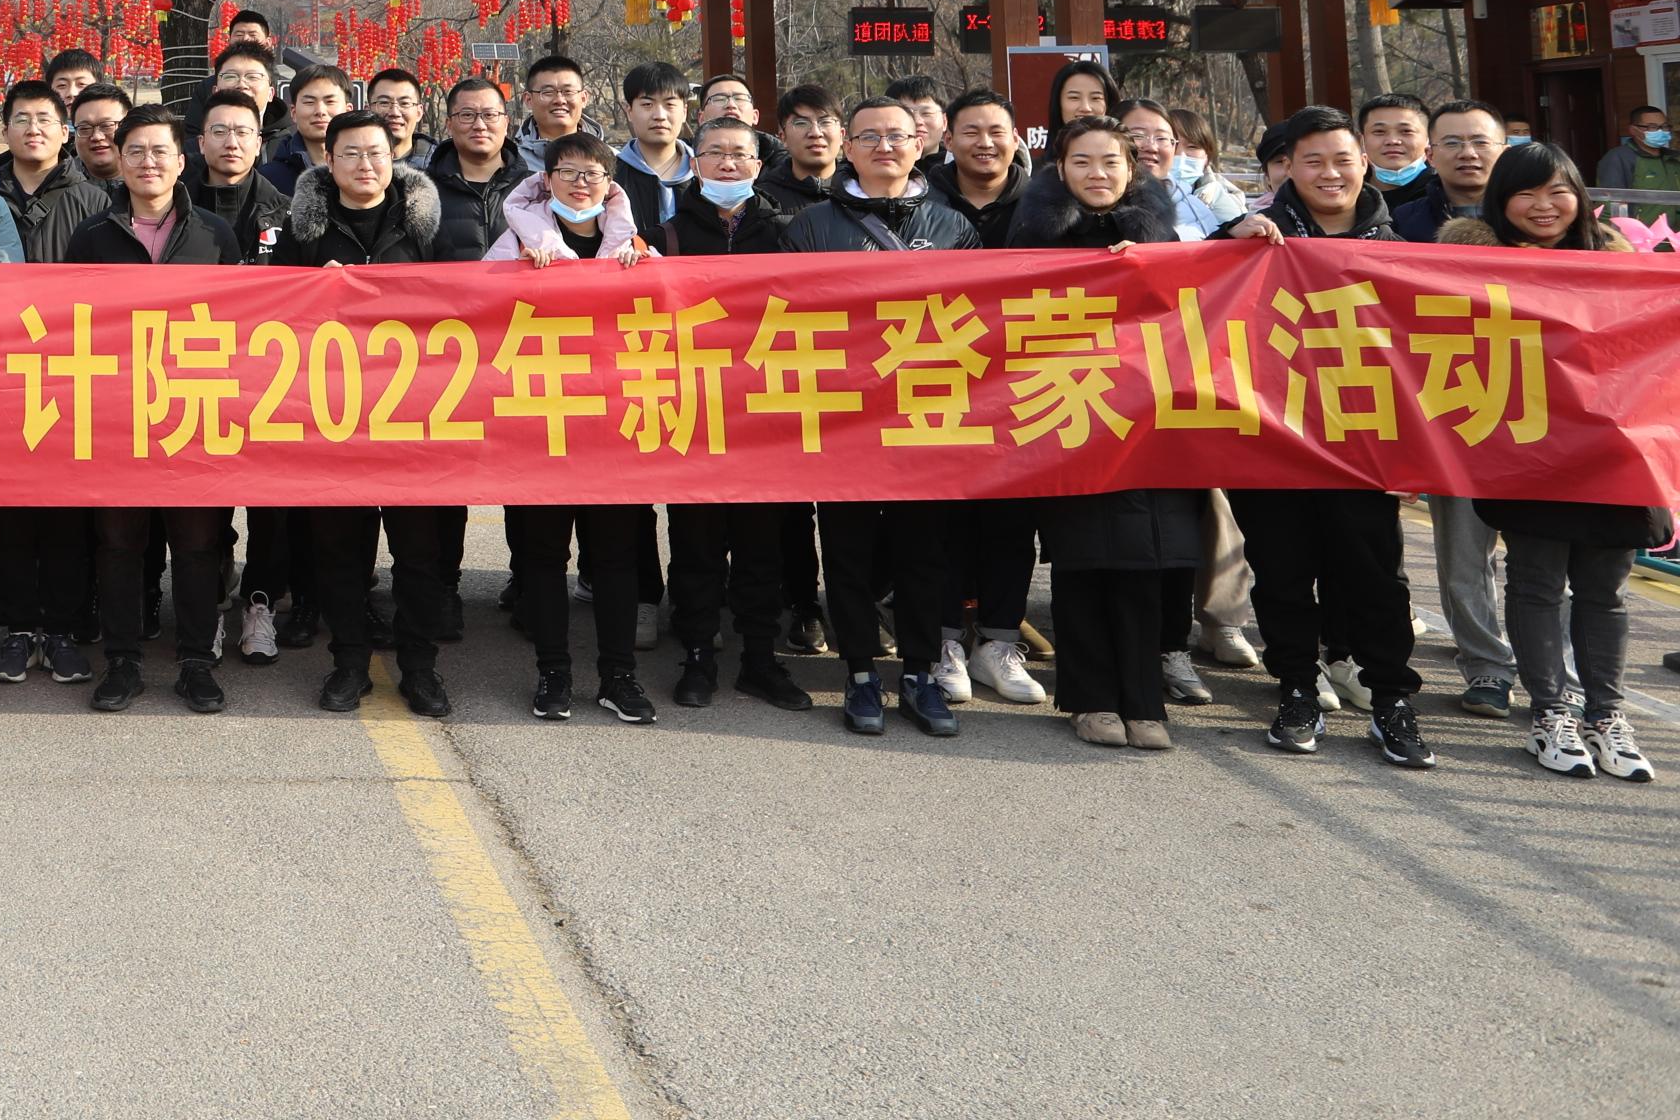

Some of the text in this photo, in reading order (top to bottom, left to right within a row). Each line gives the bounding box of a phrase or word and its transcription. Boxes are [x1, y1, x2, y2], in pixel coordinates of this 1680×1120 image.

[854, 22, 931, 44] 道团队通
[1026, 126, 1049, 150] 防
